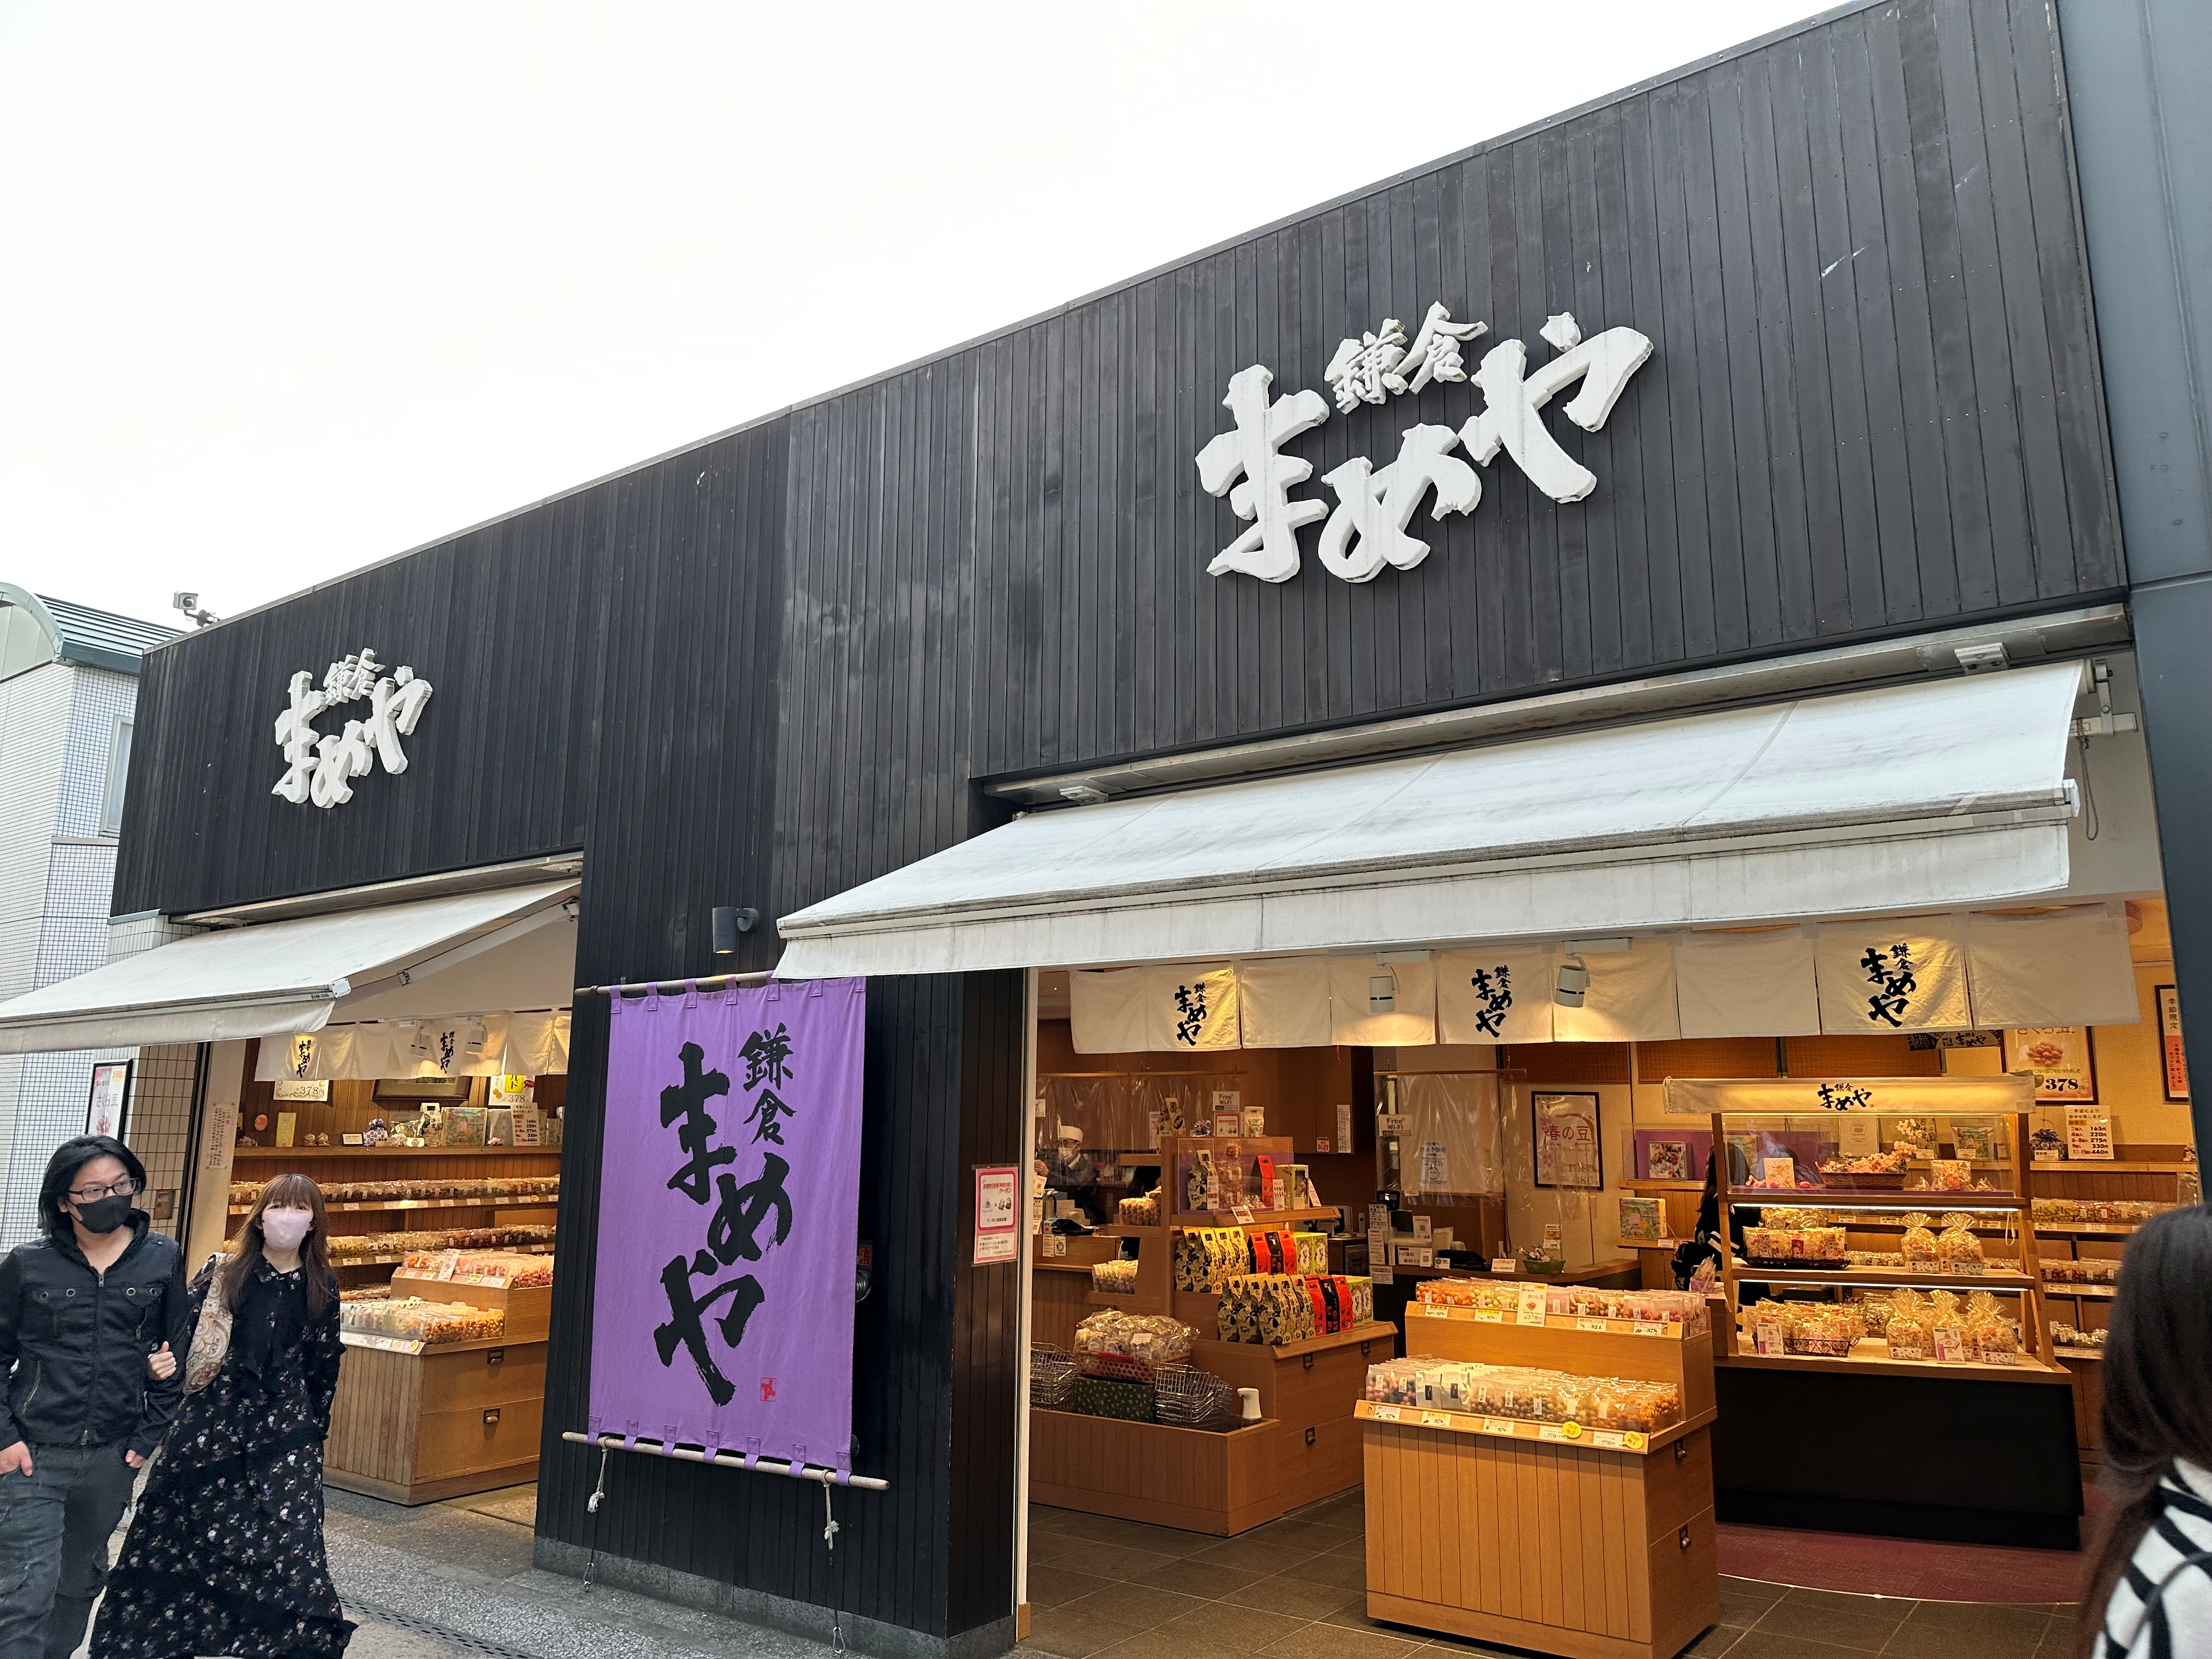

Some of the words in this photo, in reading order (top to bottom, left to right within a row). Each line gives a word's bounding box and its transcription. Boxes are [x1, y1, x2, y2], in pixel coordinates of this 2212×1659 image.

[1323, 300, 1488, 415] 鎌倉
[1195, 311, 1654, 583] まめや
[323, 647, 386, 706] 鎌倉
[272, 665, 433, 809] まめや
[1493, 964, 1512, 989] 鎌倉
[1889, 943, 1914, 970] 鎌倉
[1174, 985, 1207, 1046] まめや
[1193, 982, 1207, 1003] 鎌倉
[1471, 968, 1513, 1038] まめや
[1860, 947, 1917, 1028] まめや
[2168, 998, 2179, 1030] 季節限定
[296, 1040, 311, 1078] まめや
[440, 1032, 454, 1074] まめや
[738, 1022, 797, 1146] 鎌倉
[1817, 1084, 1872, 1111] まめや
[1549, 1124, 1591, 1141] 春の豆
[653, 1041, 794, 1407] まめや
